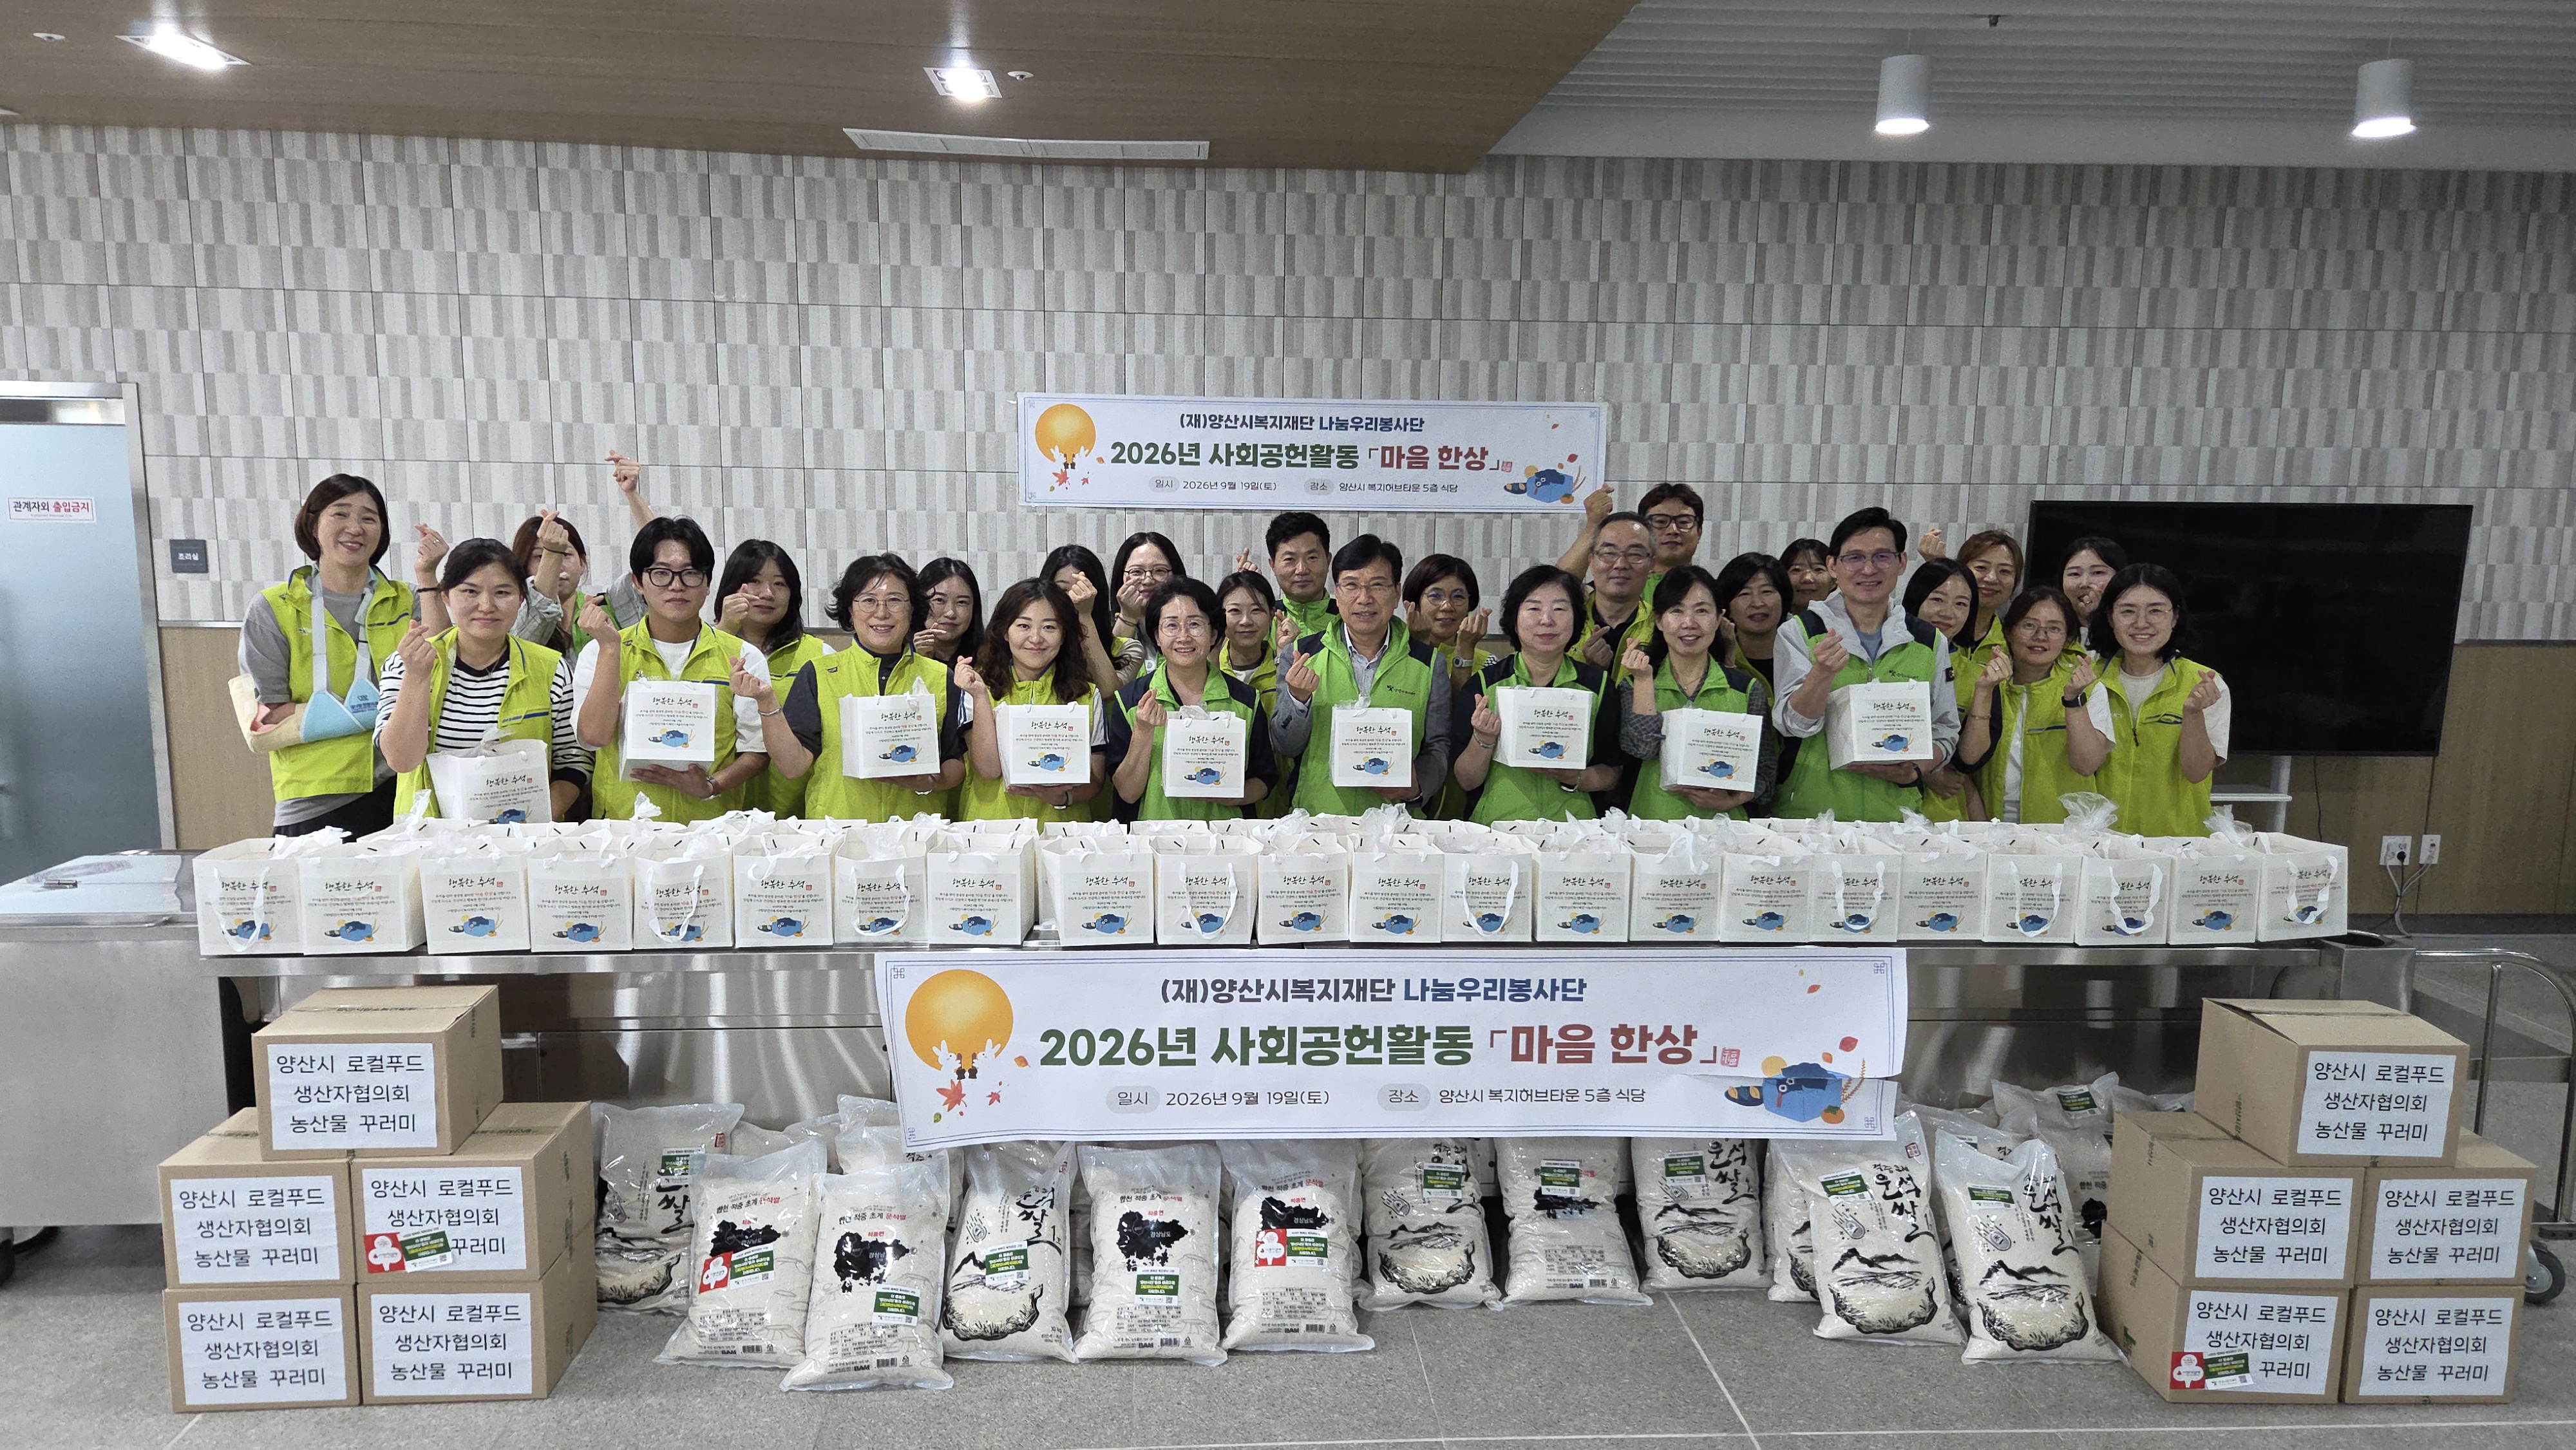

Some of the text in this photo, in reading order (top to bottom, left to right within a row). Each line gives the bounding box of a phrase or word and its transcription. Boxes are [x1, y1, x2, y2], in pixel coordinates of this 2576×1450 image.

[1180, 413, 1425, 432] (재)양산시복지재단 나눔우리봉사단
[1111, 441, 1500, 471] 2026년 사회공헌활동 「마음 한상」
[1155, 479, 1173, 488] 일시
[1183, 480, 1277, 491] 2026년 9월 19일(토)
[1310, 482, 1328, 491] 장소
[1339, 482, 1459, 493] 양산시 복지허브타운 5층 식당
[14, 501, 90, 513] 관계자외 출입금지
[652, 697, 692, 706] 행복한 추석
[1873, 701, 1910, 711] 행복한 추석
[881, 711, 916, 722] 행복한 추석
[1533, 709, 1569, 719] 행복한 추석
[1031, 720, 1068, 730] 행복한 추석
[1356, 725, 1391, 735] 행복한 추석
[1189, 735, 1225, 744] 행복한 추석
[1703, 728, 1740, 739] 행복한 추석
[486, 774, 526, 787] 행복한 추석
[325, 880, 374, 892] 행복한 추석
[448, 876, 495, 889] 행복한 추석
[761, 879, 806, 890] 행복한 추석
[857, 881, 900, 892] 행복한 추석
[952, 878, 995, 889] 행복한 추석
[1085, 875, 1128, 887] 행복한 추석
[1185, 876, 1227, 886] 행복한 추석
[1283, 874, 1325, 885] 행복한 추석
[1378, 877, 1420, 888] 행복한 추석
[1468, 876, 1511, 887] 행복한 추석
[1562, 876, 1605, 887] 행복한 추석
[1660, 878, 1701, 889] 행복한 추석
[1750, 874, 1791, 885] 행복한 추석
[1861, 877, 1878, 887] 추석
[1922, 876, 1964, 887] 행복한 추석
[2199, 873, 2239, 885] 행복한 추석
[554, 884, 600, 896] 행복한 추석
[656, 887, 681, 898] 행복한
[1161, 977, 1587, 1004] (재)양산시복지재단 나눔우리봉사단
[1039, 1023, 1718, 1067] 2026년 사회공헌활동 「마음 한상」
[276, 1055, 424, 1074] 양산시 로컬푸드
[2315, 1062, 2445, 1084] 양산시 로컬푸드
[294, 1084, 410, 1104] 생산자협의회
[1117, 1091, 1148, 1106] 일시
[1166, 1091, 1329, 1106] 2026년 9월 19일(토)
[1388, 1089, 1419, 1103] 장소
[1439, 1088, 1646, 1104] 양산시 복지허브타운 5층 식당
[2324, 1092, 2427, 1113] 생산자협의회
[290, 1114, 415, 1133] 농산물 꾸러미
[2315, 1121, 2428, 1142] 농산물 꾸러미
[371, 1179, 513, 1198] 양산시 로컬푸드
[179, 1188, 325, 1209] 양산시 로컬푸드
[2209, 1187, 2342, 1207] 양산시 로컬푸드
[2385, 1189, 2515, 1208] 양산시 로컬푸드
[388, 1208, 498, 1227] 생산자협의회
[197, 1217, 311, 1239] 생산자협의회
[2220, 1217, 2325, 1236] 생산자협의회
[2395, 1218, 2498, 1236] 생산자협의회
[450, 1238, 506, 1256] 꾸러미
[2213, 1245, 2327, 1264] 농산물 꾸러미
[194, 1247, 318, 1268] 농산물 꾸러미
[2387, 1246, 2500, 1265] 농산물 꾸러미
[379, 1304, 521, 1323] 양산시 로컬푸드
[2197, 1301, 2326, 1324] 양산시 로컬푸드
[2375, 1308, 2503, 1326] 양산시 로컬푸드
[187, 1310, 333, 1332] 양산시 로컬푸드
[395, 1333, 506, 1352] 생산자협의회
[2206, 1330, 2309, 1351] 생산자협의회
[2385, 1336, 2486, 1354] 생산자협의회
[204, 1339, 318, 1361] 생산자협의회
[391, 1362, 512, 1381] 농산물 꾸러미
[2259, 1361, 2310, 1379] 꾸러미
[2377, 1364, 2488, 1382] 농산물 꾸러미
[202, 1368, 325, 1389] 농산물 꾸러미
